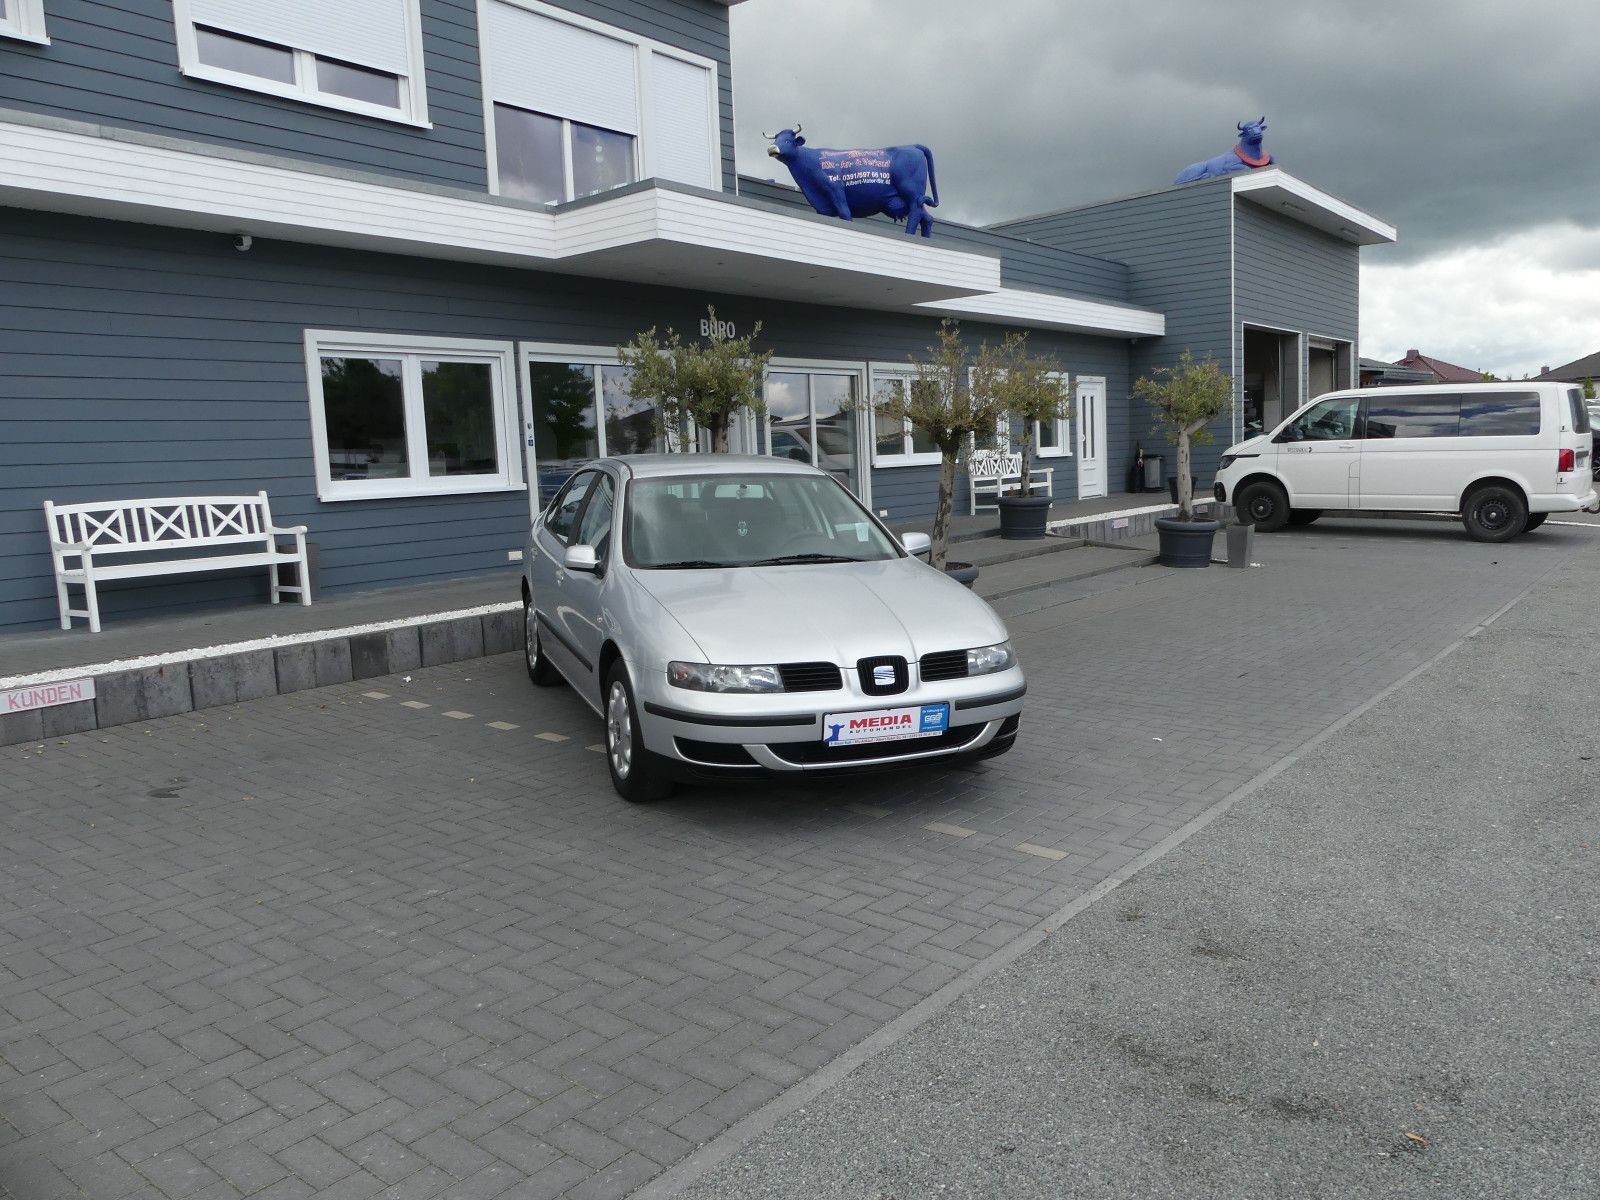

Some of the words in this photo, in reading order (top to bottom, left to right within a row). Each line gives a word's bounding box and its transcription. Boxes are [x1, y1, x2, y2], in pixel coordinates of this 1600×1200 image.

[829, 174, 841, 182] Tel.
[7, 683, 82, 710] KUNDEN
[849, 714, 912, 729] MEDIA
[849, 725, 912, 734] AUTOHANDEL
